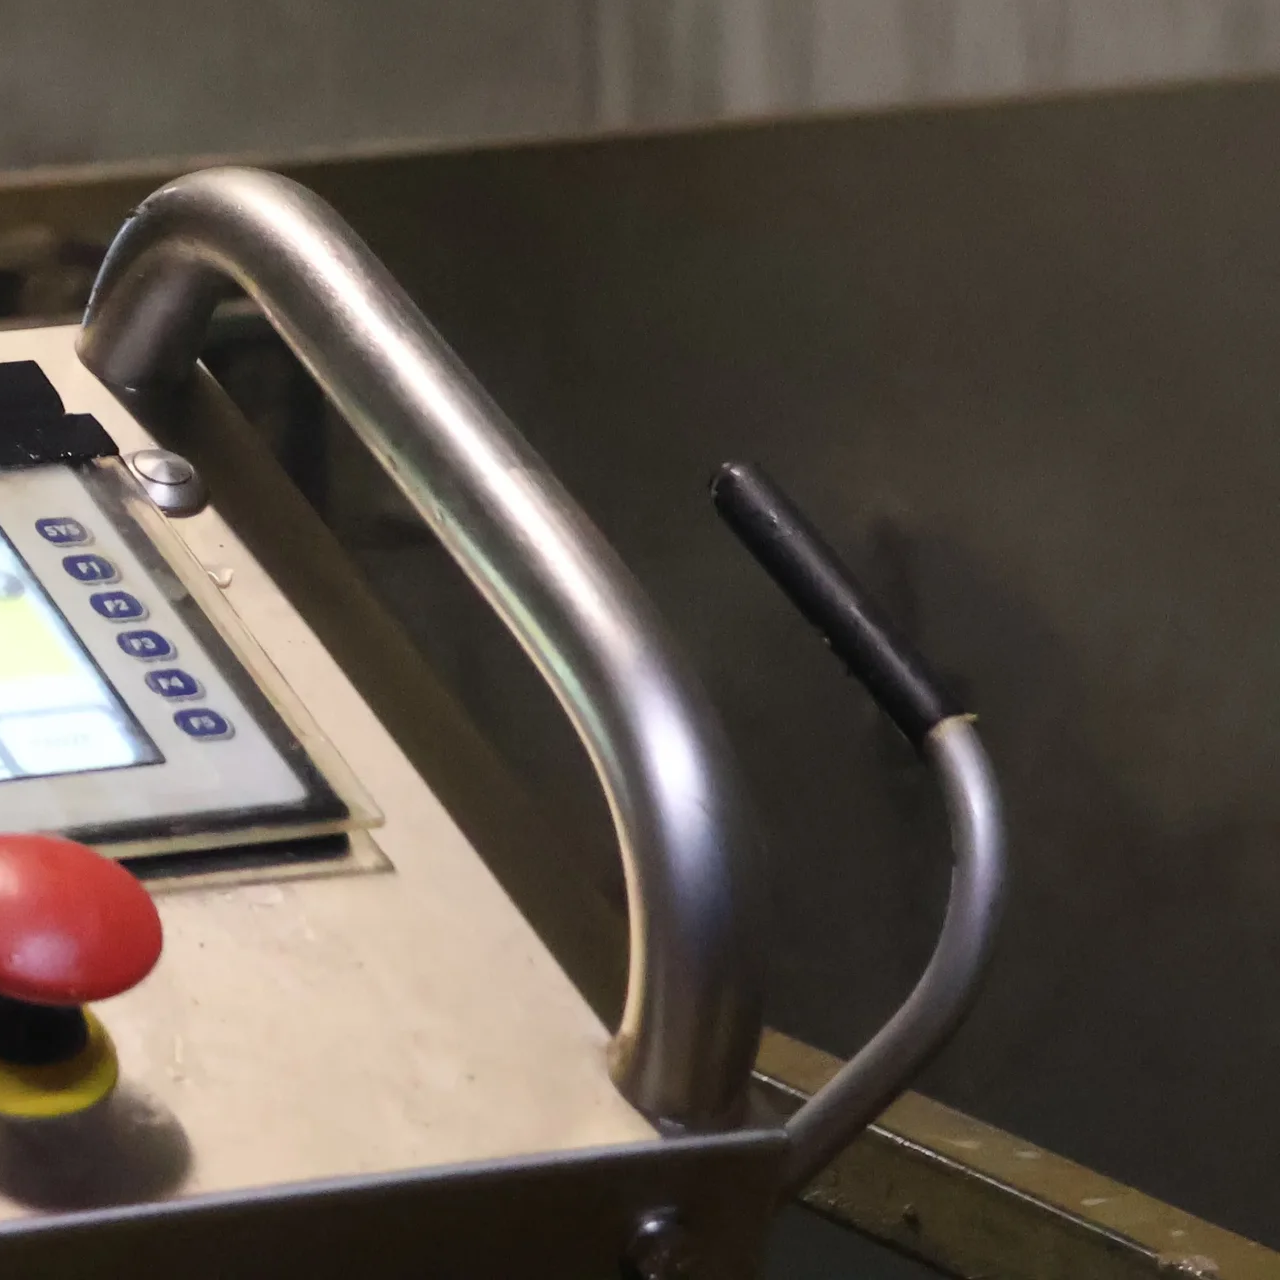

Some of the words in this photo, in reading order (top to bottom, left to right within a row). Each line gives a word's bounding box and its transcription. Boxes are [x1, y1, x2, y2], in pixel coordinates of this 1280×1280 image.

[43, 523, 82, 537] SYS
[77, 561, 101, 577] F1
[103, 599, 130, 613] F2
[130, 637, 157, 651] F3
[157, 676, 185, 690] F4
[188, 716, 217, 731] F5
